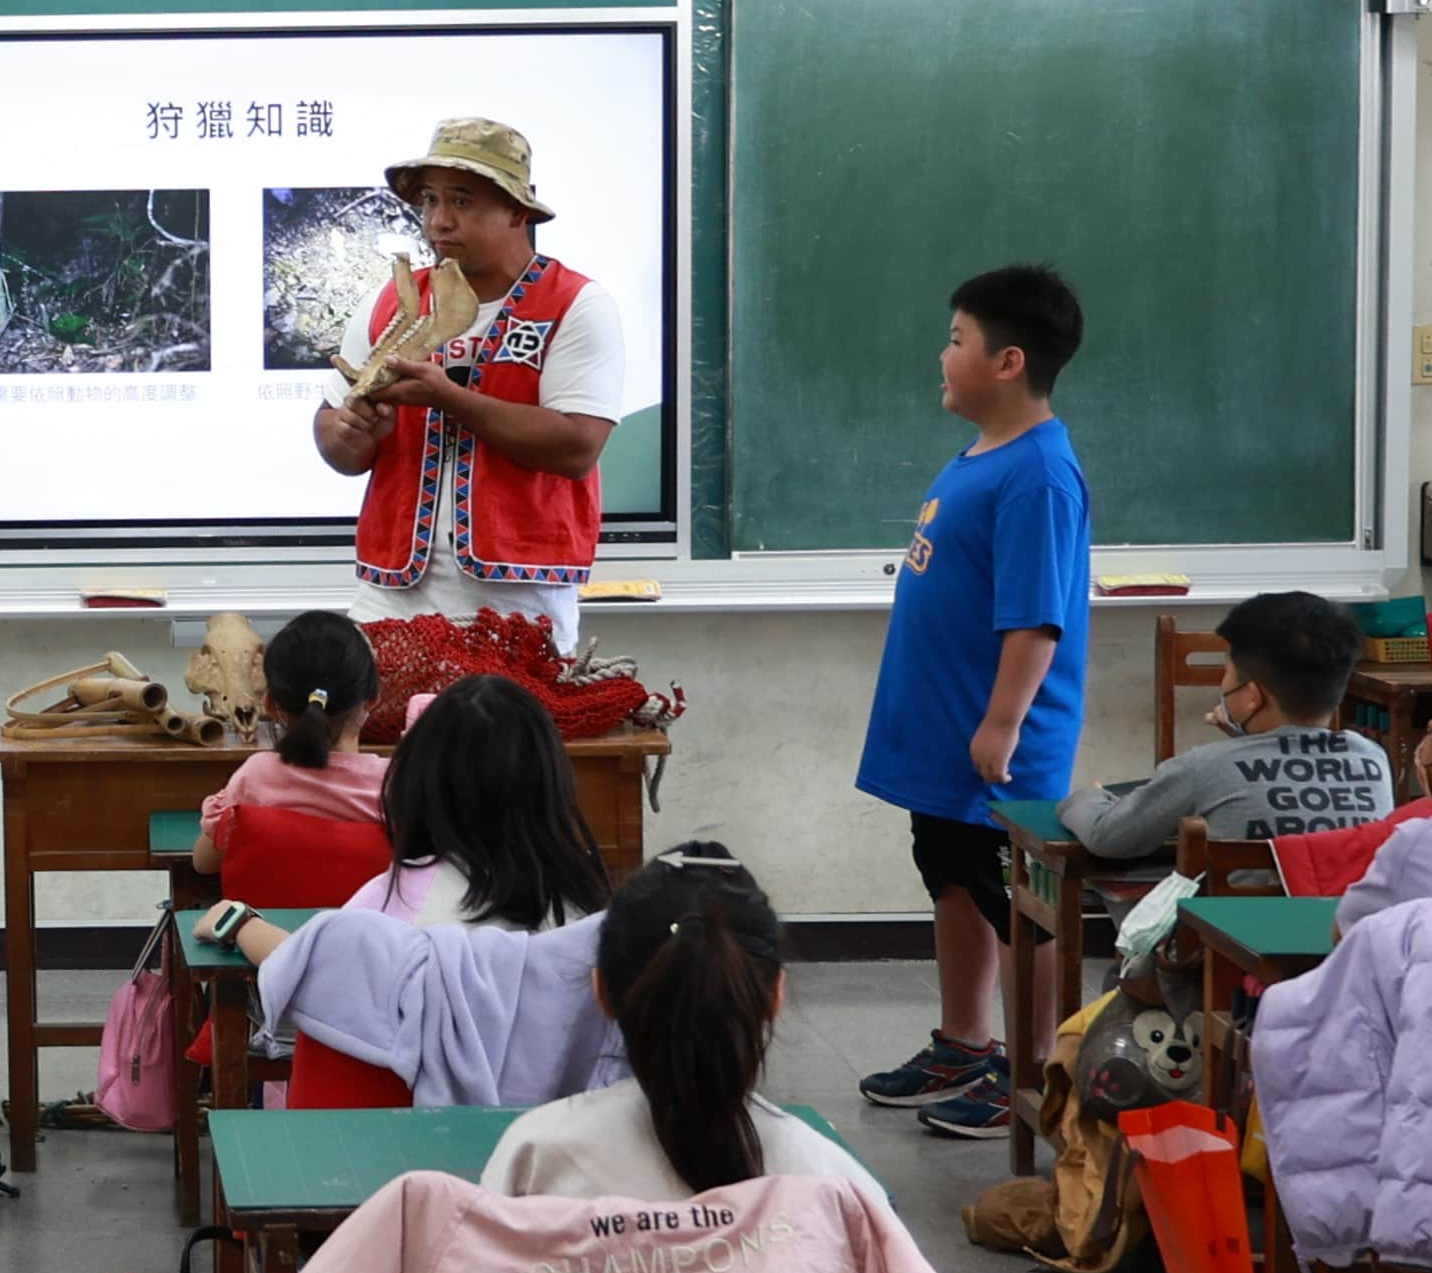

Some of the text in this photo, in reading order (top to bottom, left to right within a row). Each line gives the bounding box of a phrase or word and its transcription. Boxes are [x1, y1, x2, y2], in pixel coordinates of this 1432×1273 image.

[146, 98, 335, 140] 狩獵知識
[1279, 732, 1349, 755] THE
[1235, 757, 1383, 783] WORLD
[1267, 786, 1376, 812] GOES
[590, 1202, 736, 1239] we are the
